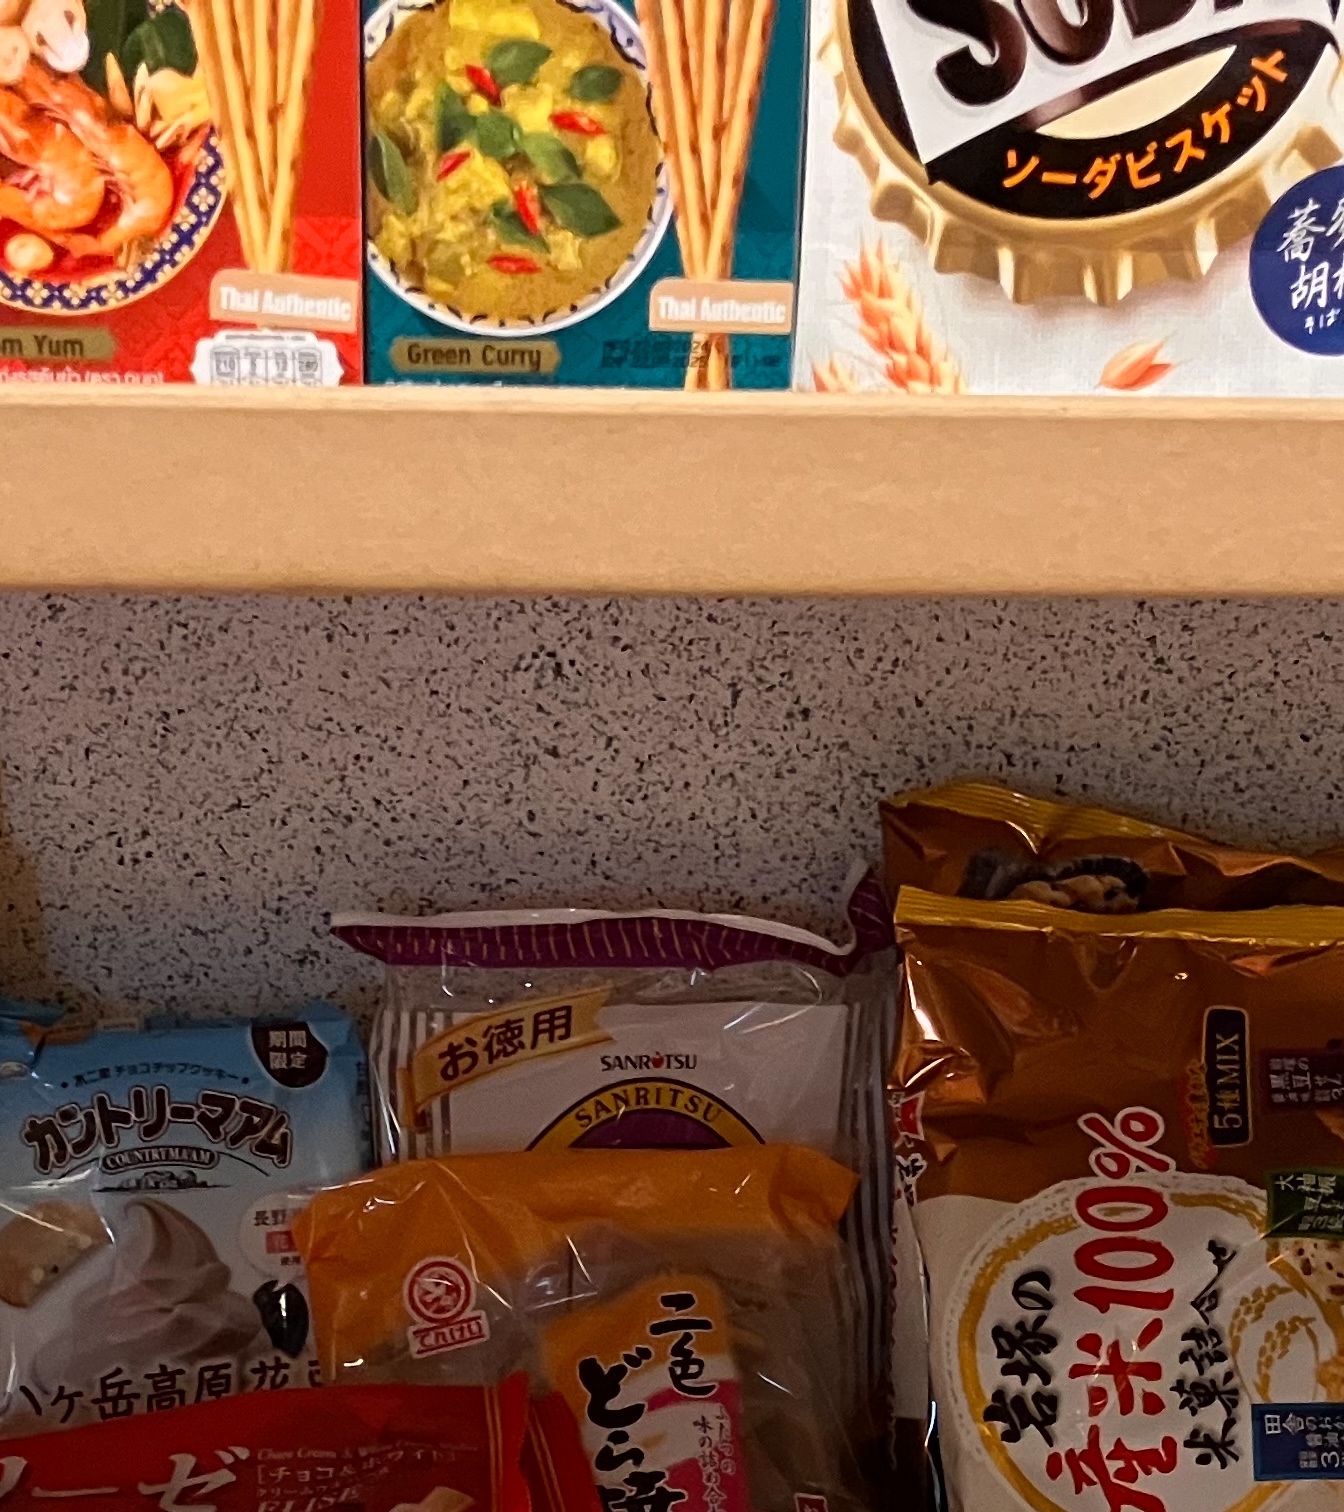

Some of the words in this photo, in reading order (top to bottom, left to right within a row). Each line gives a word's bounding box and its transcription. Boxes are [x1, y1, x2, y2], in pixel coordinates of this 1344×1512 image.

[1002, 48, 1288, 199] ソーダビスケット
[219, 285, 259, 313] Thai
[263, 288, 352, 322] Authentic
[659, 297, 696, 320] Thai
[701, 297, 787, 324] Authentic
[35, 333, 85, 357] Yum
[407, 343, 471, 367] Green
[482, 344, 542, 371] Curry
[268, 1030, 308, 1048] 期間
[438, 1004, 574, 1083] お徳用
[268, 1052, 308, 1070] 限定
[575, 1086, 724, 1130] SANRITSU
[22, 1085, 294, 1174] カントリーマアム
[649, 1291, 718, 1397] 二色
[983, 1270, 1061, 1448] 岩塚の
